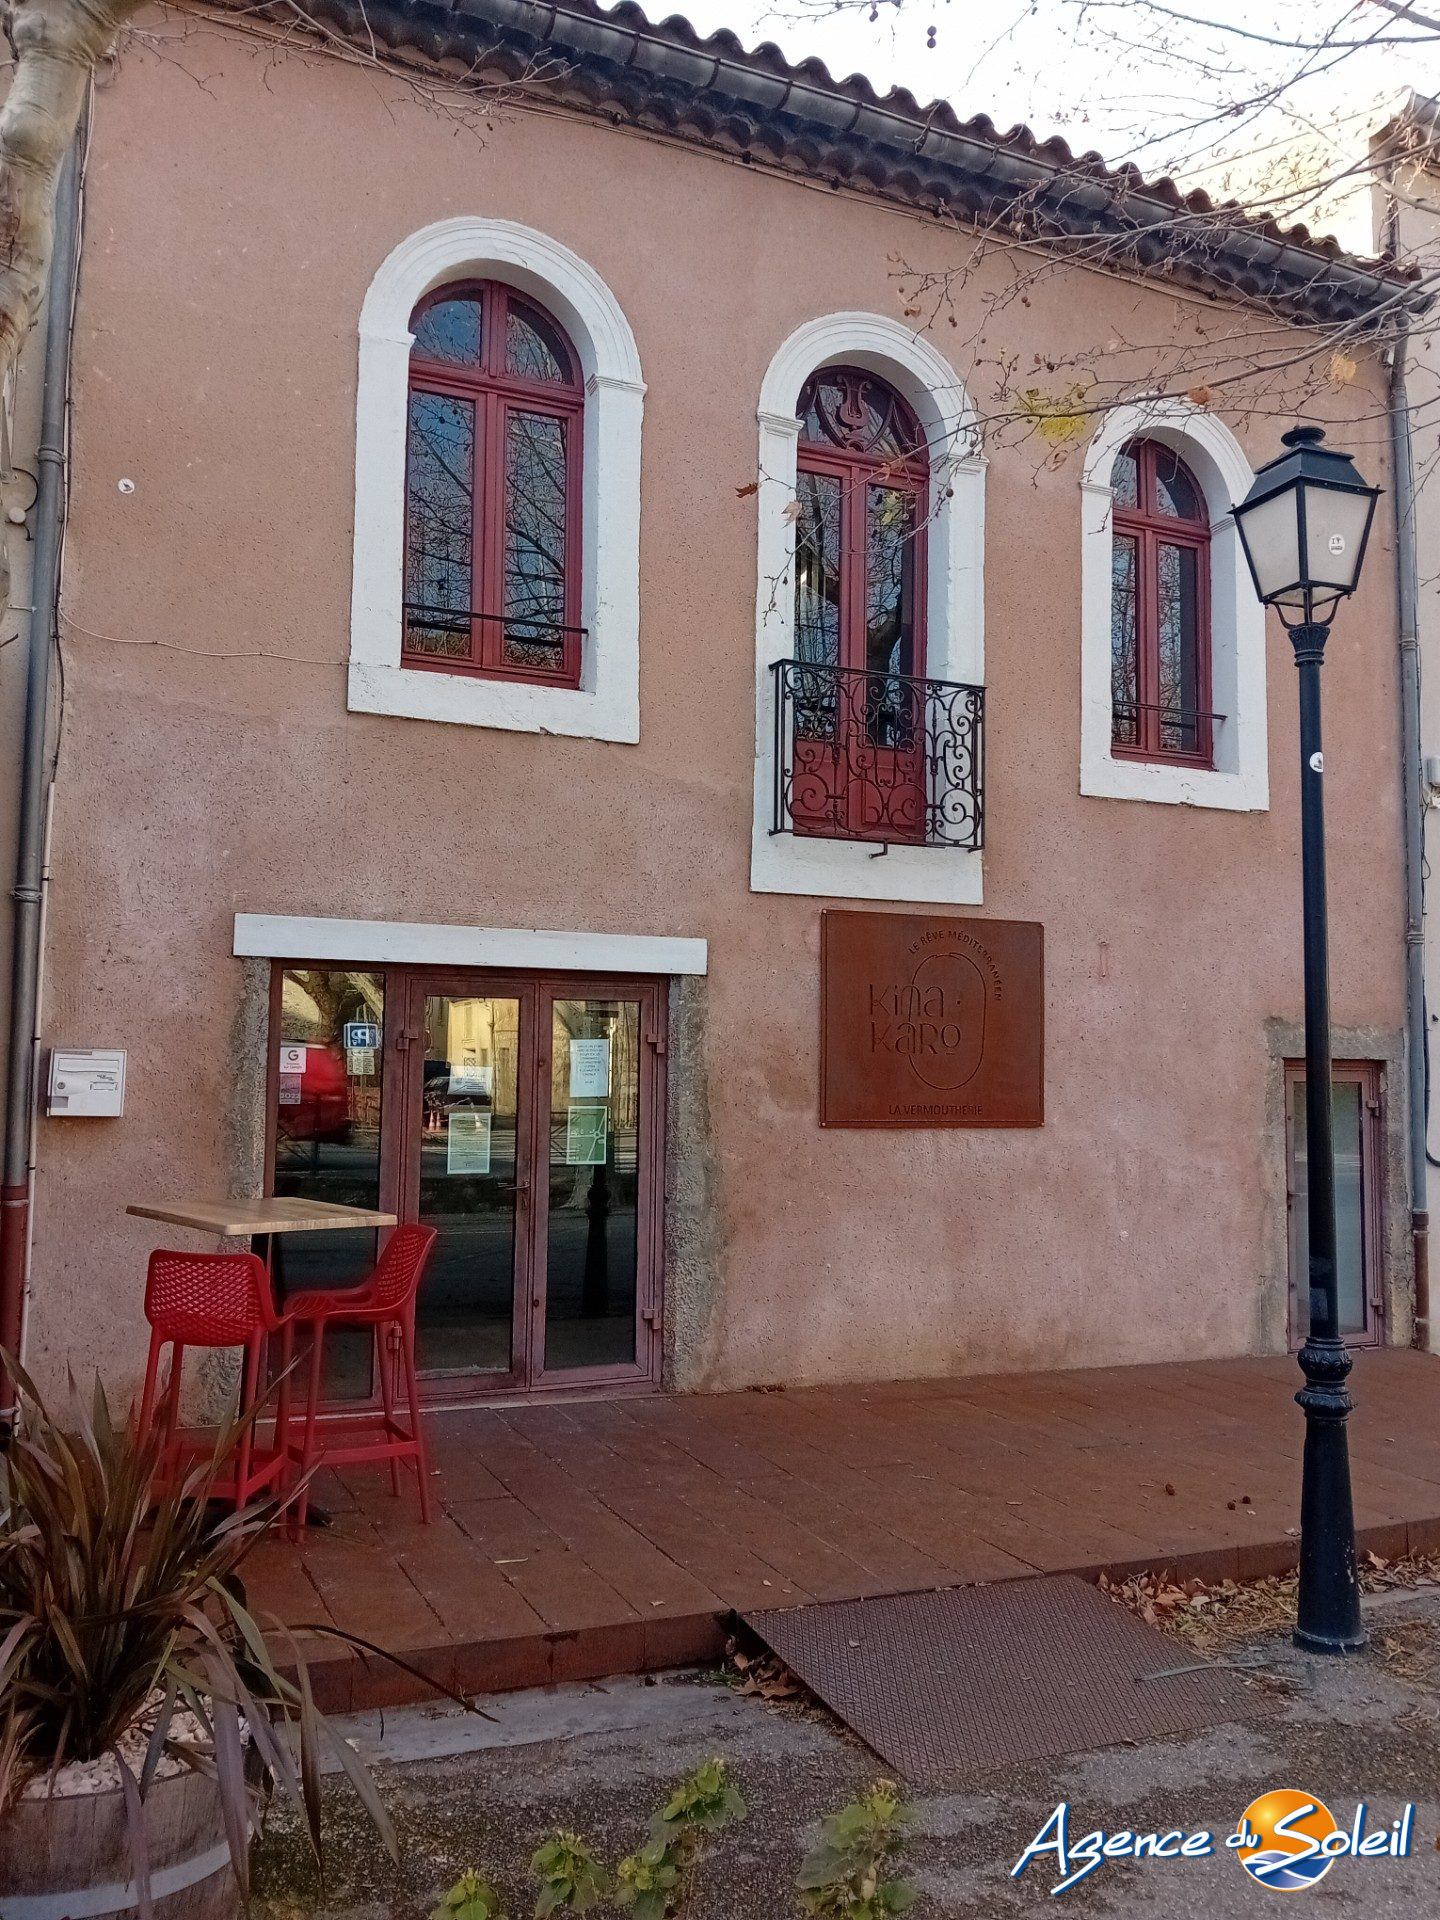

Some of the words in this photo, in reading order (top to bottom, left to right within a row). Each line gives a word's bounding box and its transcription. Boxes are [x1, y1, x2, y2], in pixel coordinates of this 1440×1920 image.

[908, 942, 920, 954] LE
[920, 929, 944, 946] RÊVE
[889, 1104, 901, 1115] LA
[903, 1104, 983, 1116] VERMOUTHERIE
